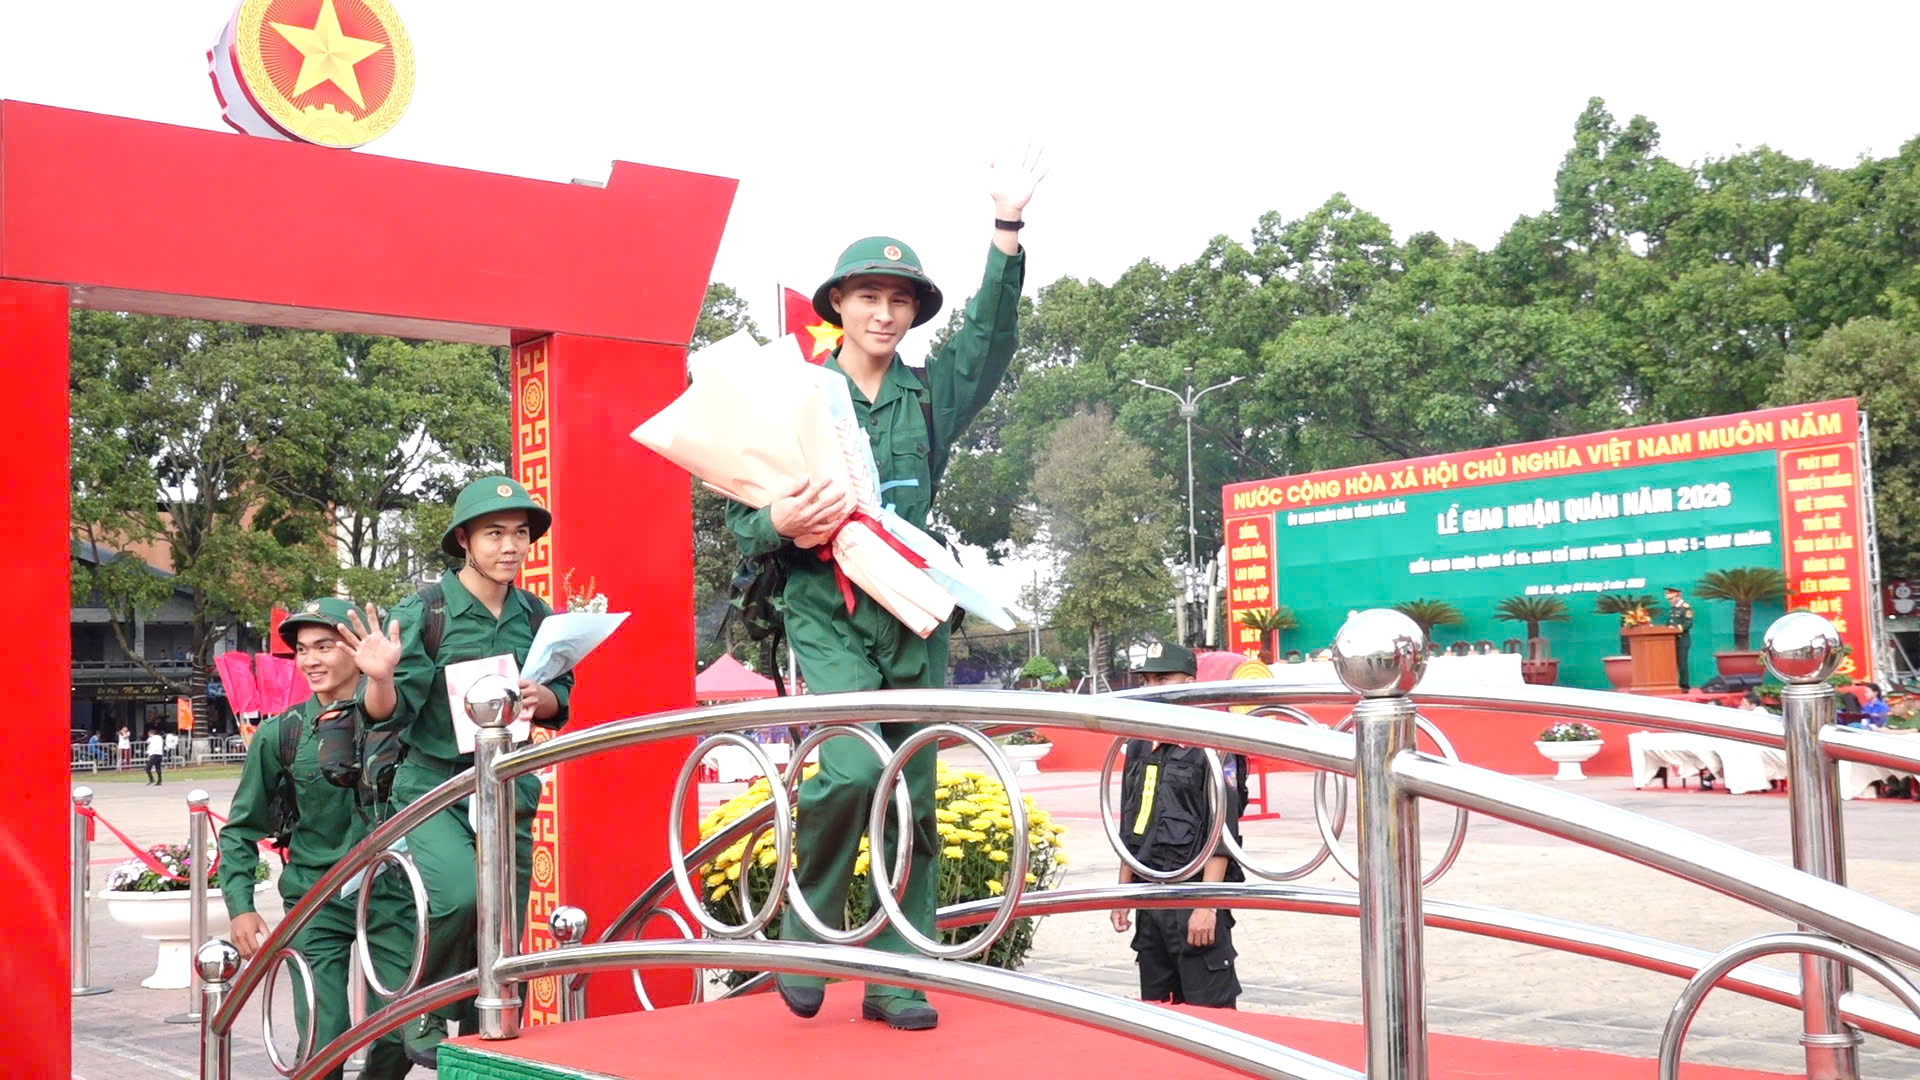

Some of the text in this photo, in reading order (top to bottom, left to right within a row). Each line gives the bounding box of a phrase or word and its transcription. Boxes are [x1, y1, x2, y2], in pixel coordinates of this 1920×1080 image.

[1234, 412, 1841, 510] NƯỚC CỘNG HÒA XÃ HỘI CHỦ NGHĨA VIỆT NAM MUÔN NĂM
[1437, 481, 1731, 535] LỄ GIAO NHẬN QUÂN NĂM 2026
